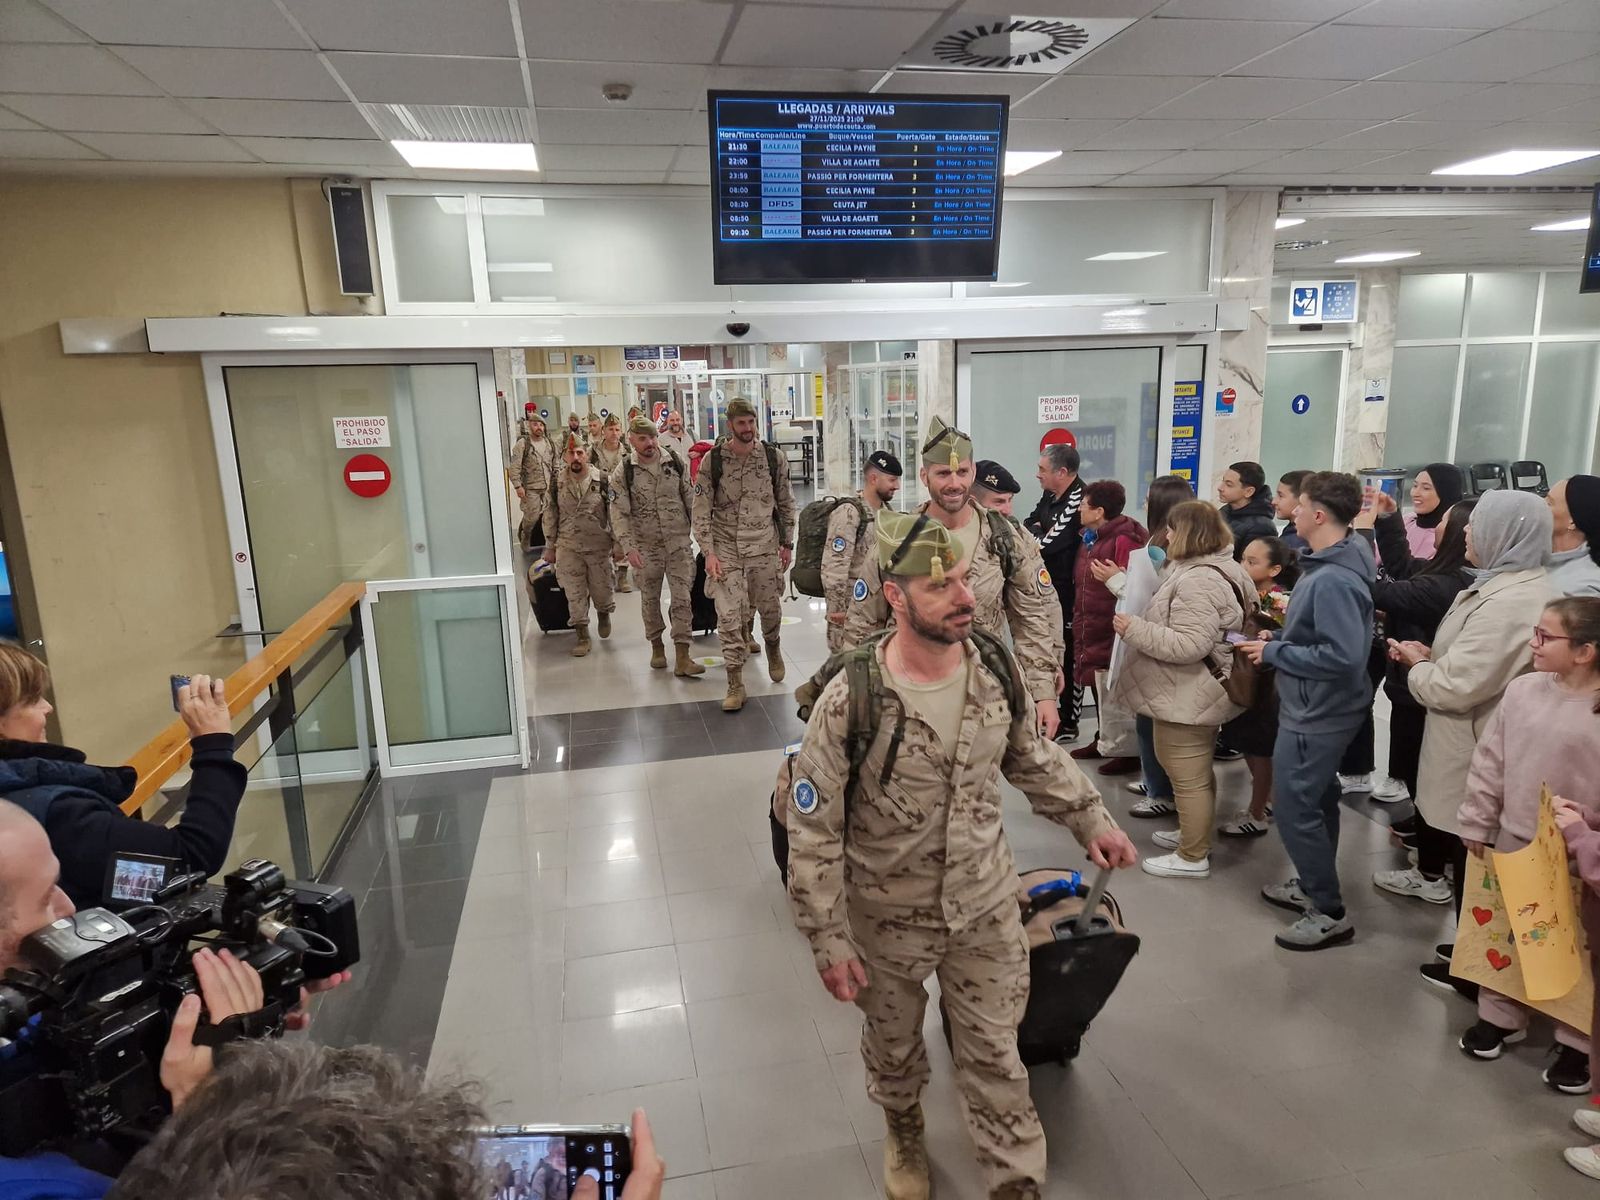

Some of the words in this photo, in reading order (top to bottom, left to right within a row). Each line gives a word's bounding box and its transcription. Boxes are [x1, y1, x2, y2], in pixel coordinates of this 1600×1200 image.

[778, 103, 833, 114] LLEGADAS
[836, 104, 840, 114] /
[843, 104, 895, 115] ARRIVALS
[336, 419, 385, 427] PROHIBIDO
[342, 438, 382, 446] "SALIDA"
[1079, 434, 1112, 449] ARQUE
